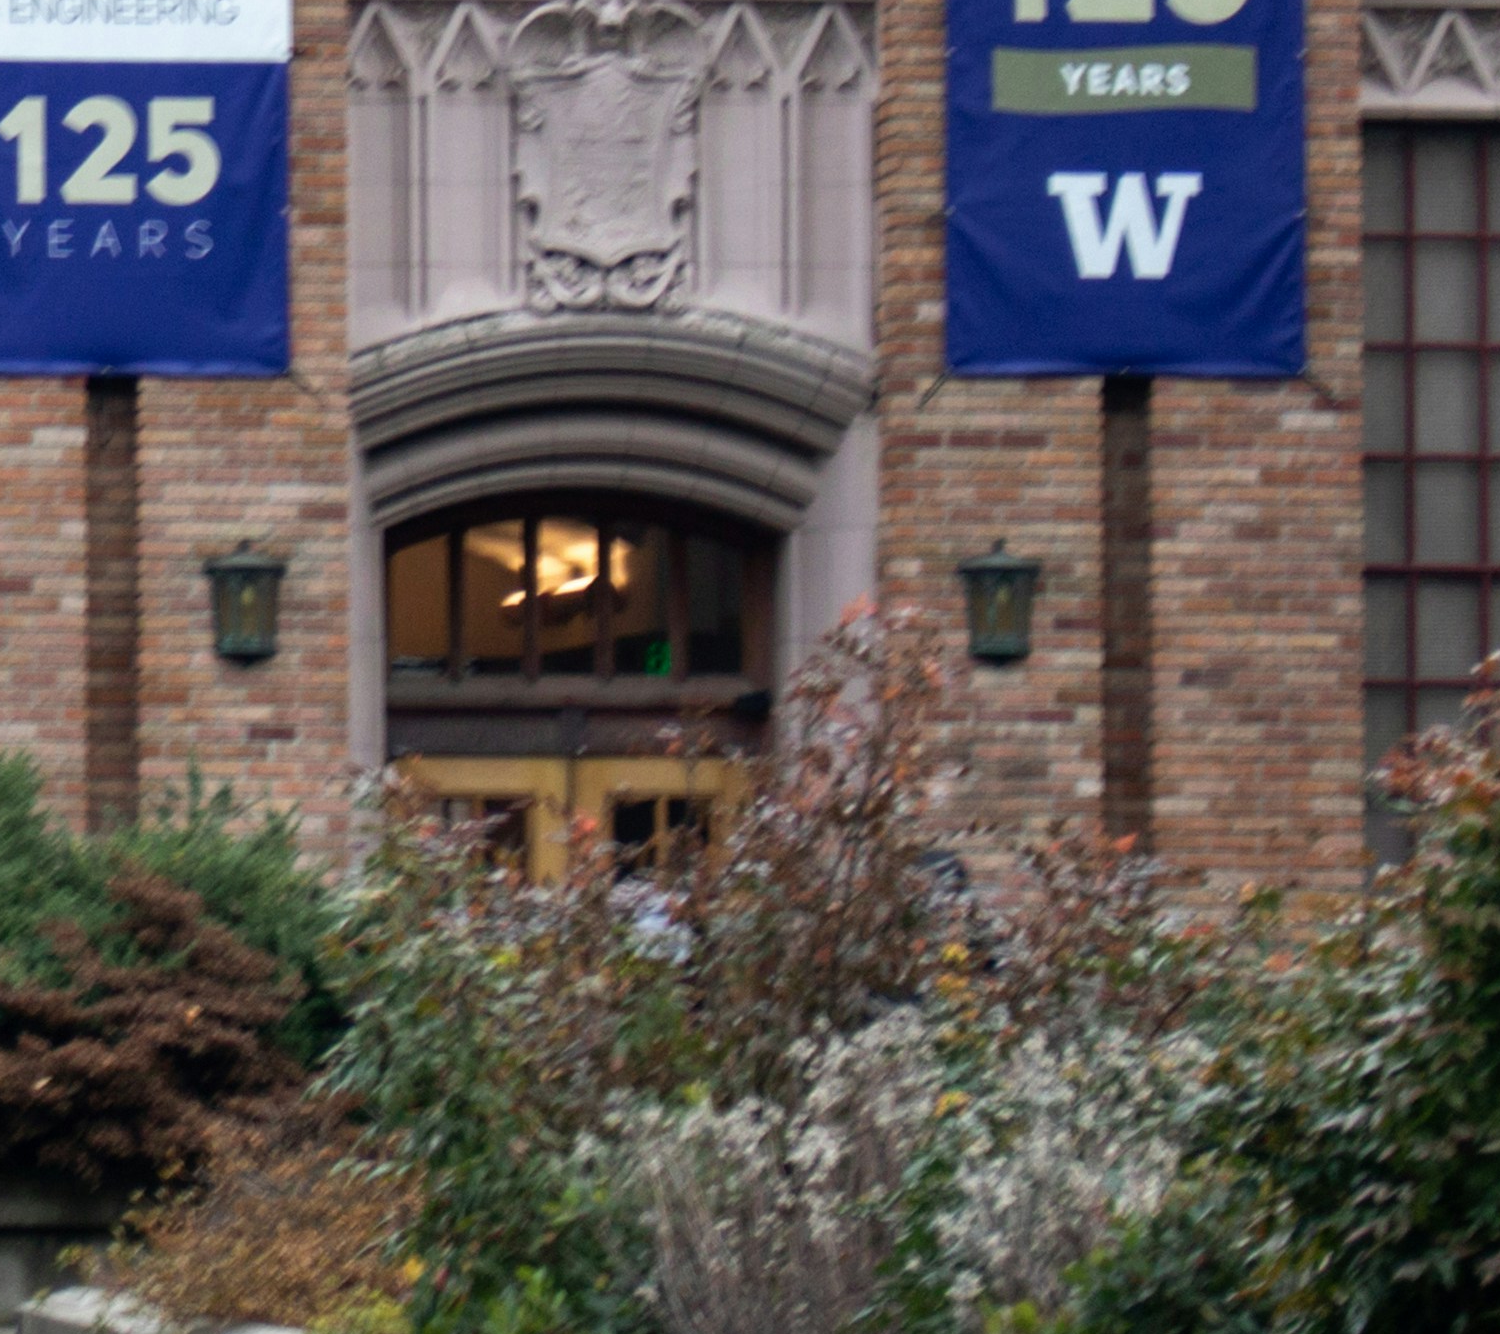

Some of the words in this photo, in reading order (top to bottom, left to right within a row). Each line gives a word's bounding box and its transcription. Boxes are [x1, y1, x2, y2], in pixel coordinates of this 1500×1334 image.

[1060, 63, 1191, 98] YEARS
[0, 218, 215, 260] YEARS
[1047, 172, 1203, 279] W
